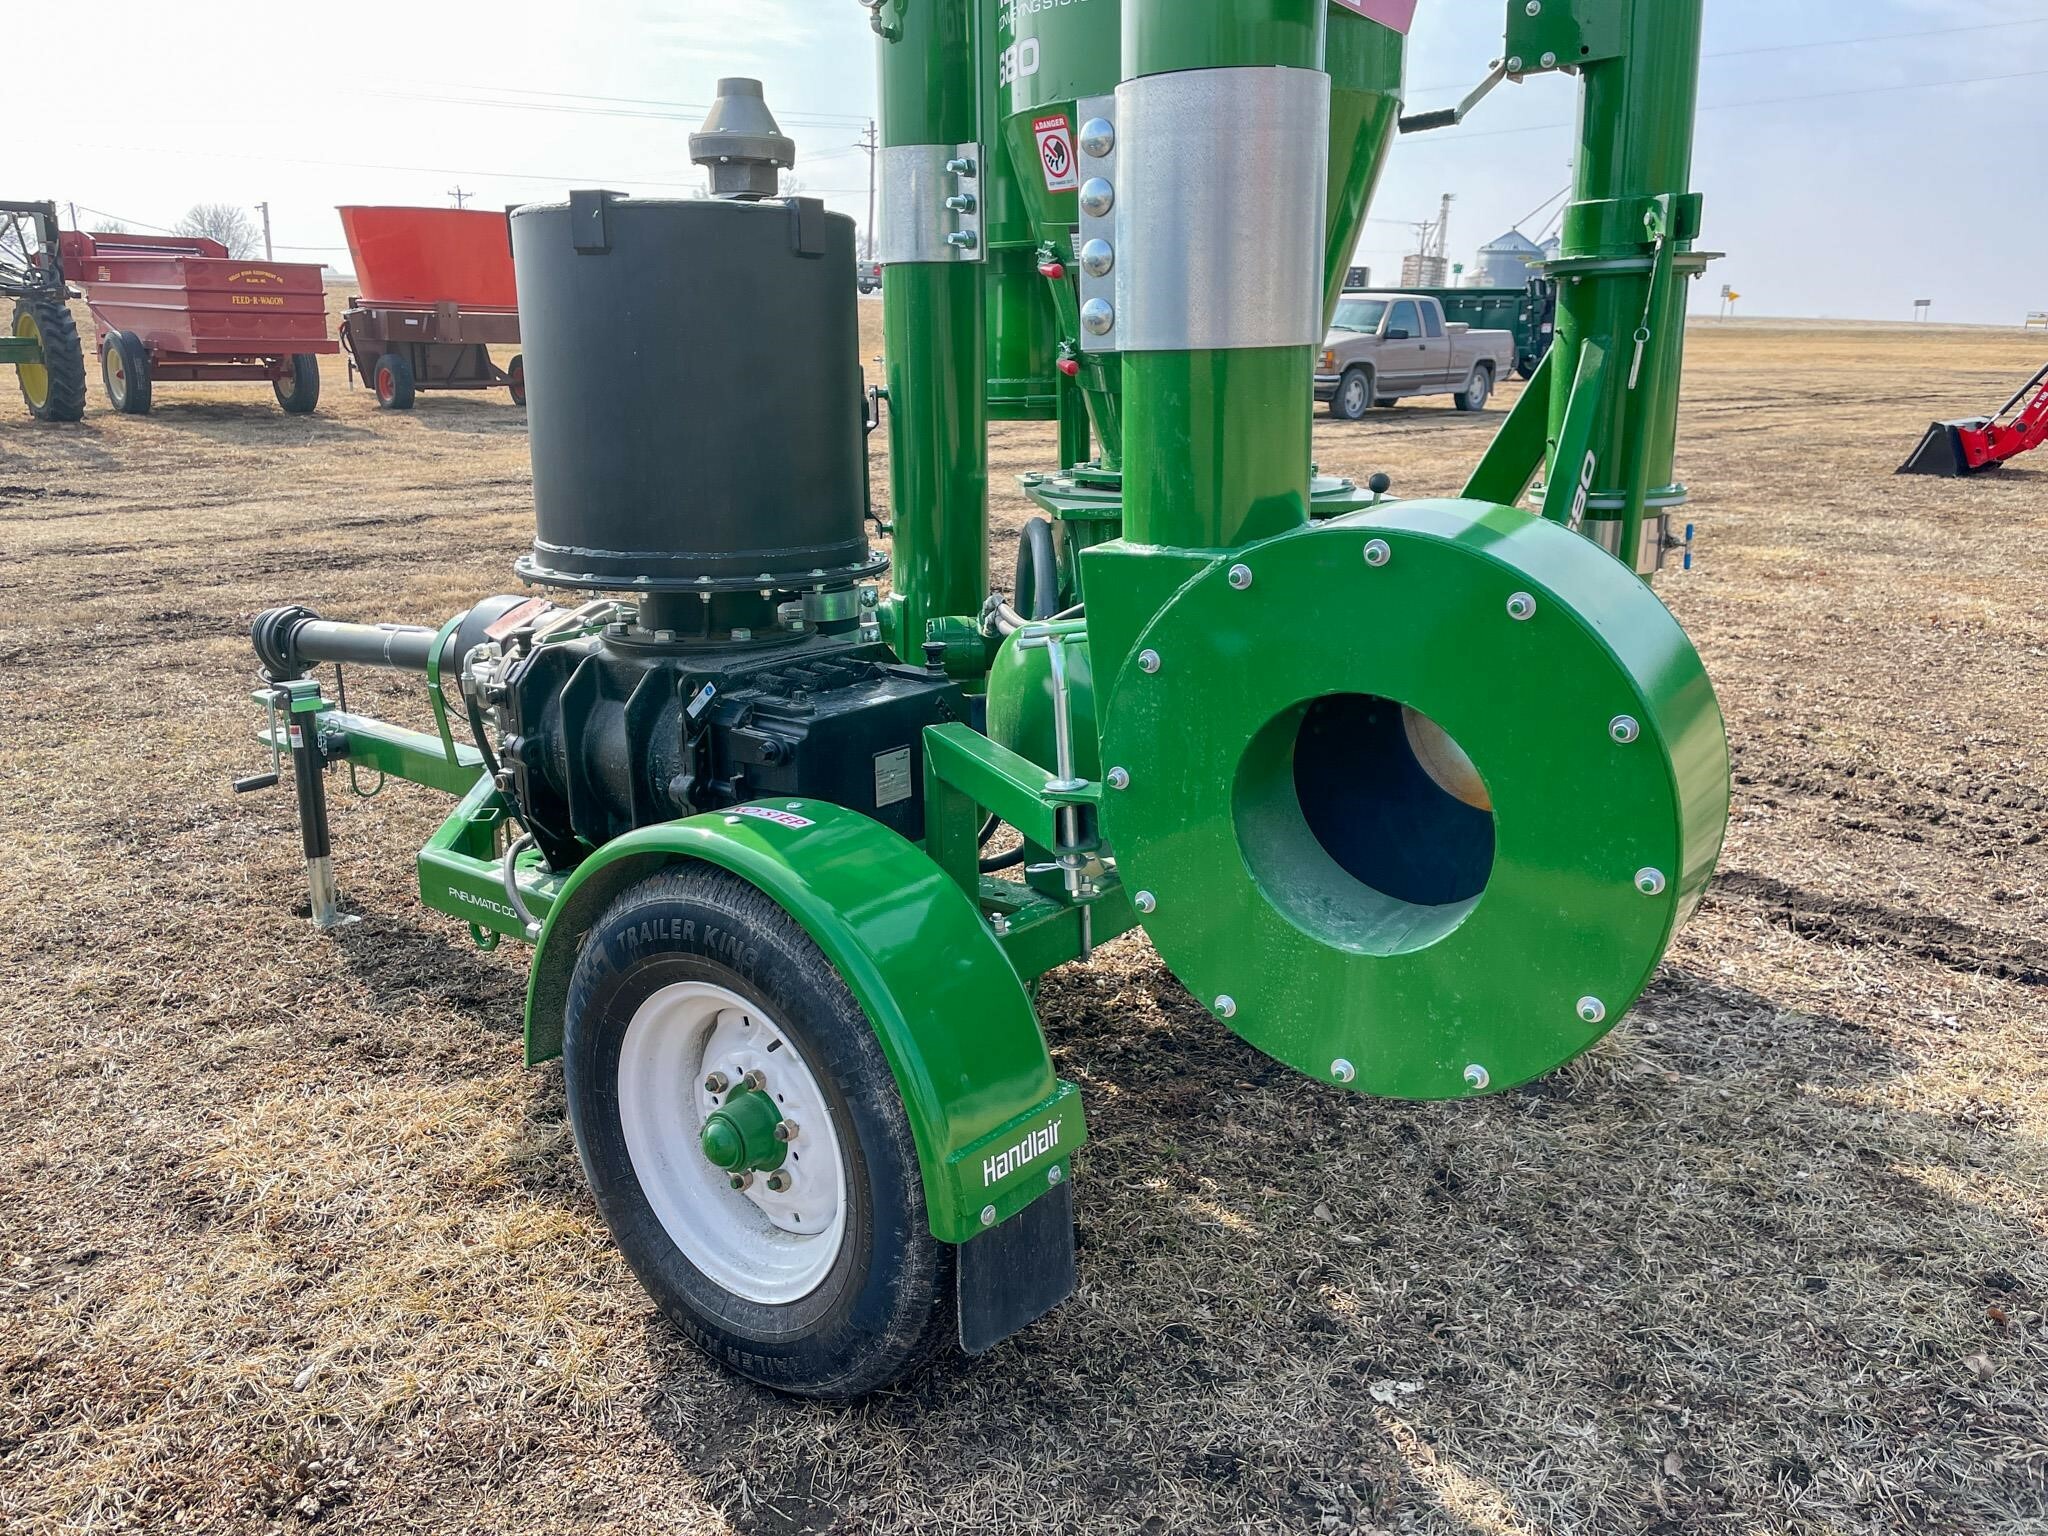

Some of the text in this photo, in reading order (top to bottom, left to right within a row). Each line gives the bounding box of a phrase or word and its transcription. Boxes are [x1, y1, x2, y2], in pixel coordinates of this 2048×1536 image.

[1040, 118, 1065, 129] DANGER
[232, 295, 284, 305] FEED-R-WAGON
[758, 811, 809, 826] STEP
[448, 886, 501, 913] PNEUMATIC
[616, 918, 760, 967] TRAILER KING
[983, 1119, 1062, 1187] Handlair
